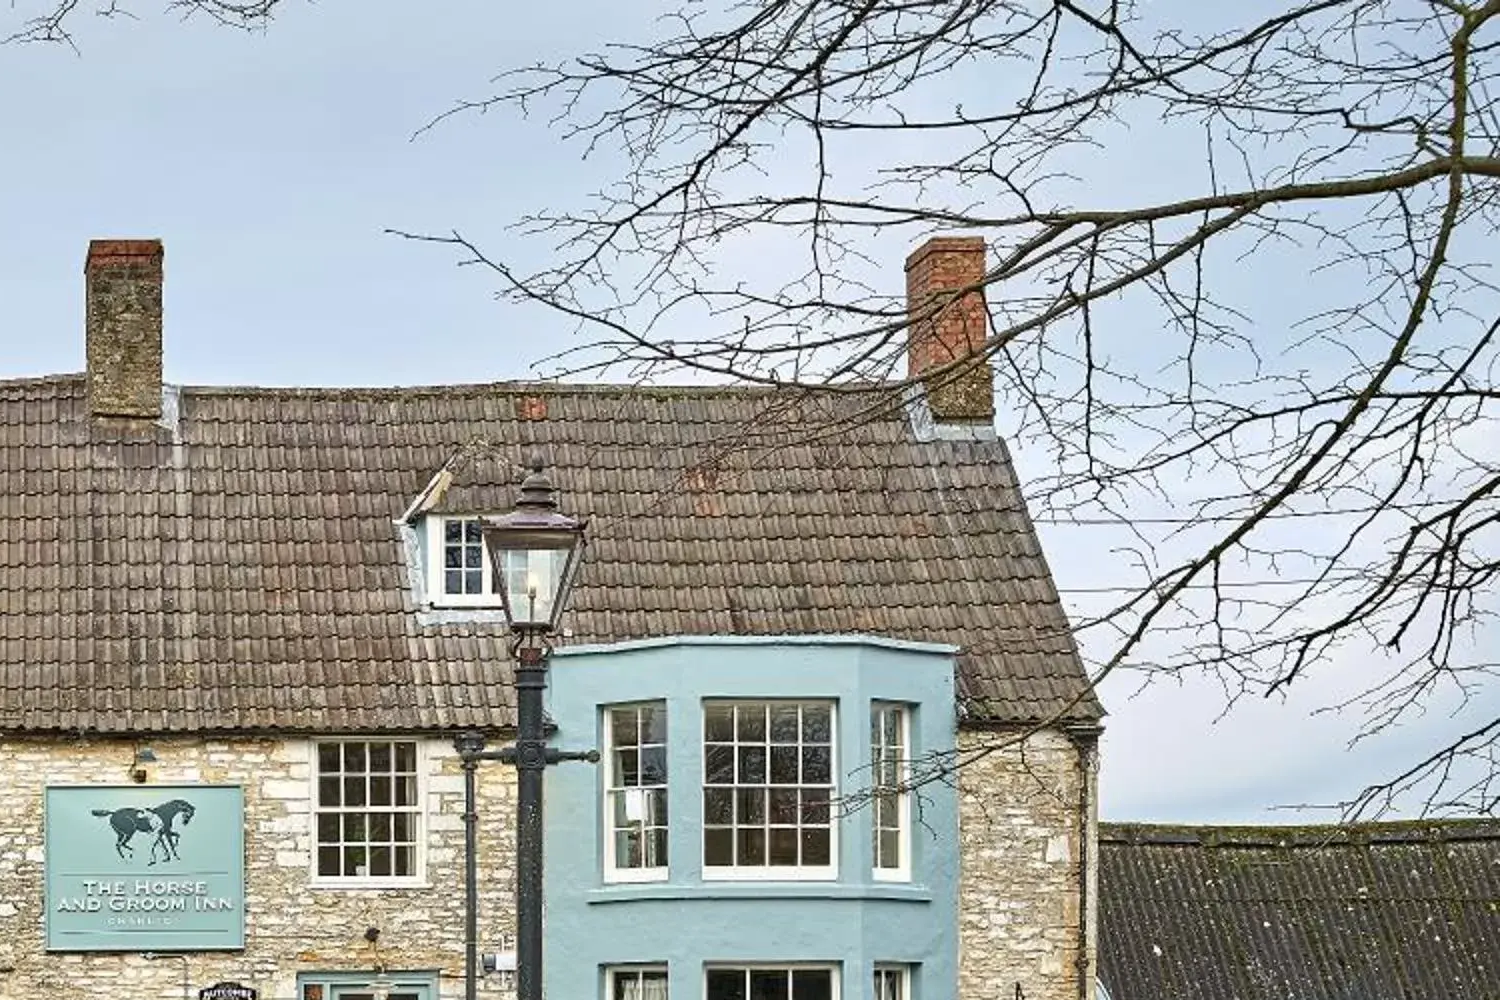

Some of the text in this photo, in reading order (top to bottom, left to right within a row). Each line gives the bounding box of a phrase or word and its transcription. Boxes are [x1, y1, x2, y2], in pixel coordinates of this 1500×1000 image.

[83, 879, 208, 897] THE HORSE
[57, 896, 234, 912] AND GROOM INN
